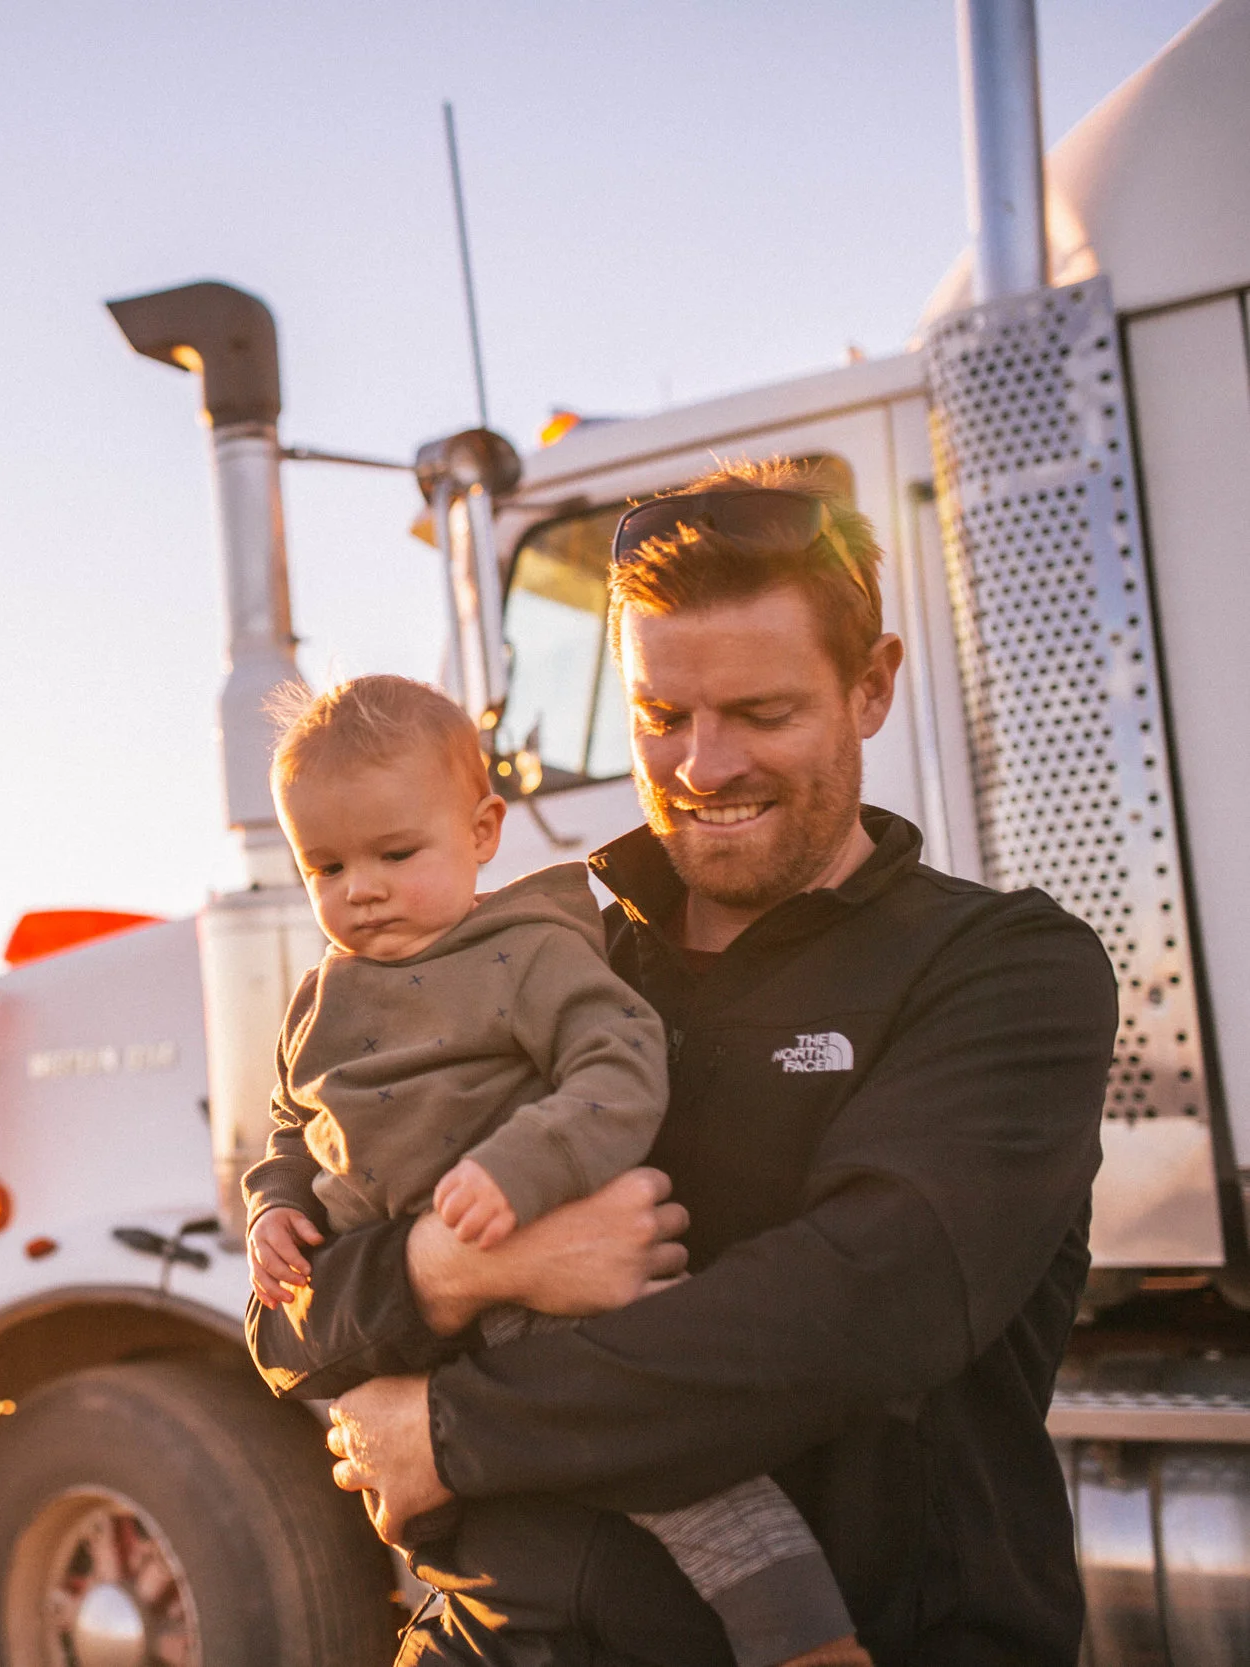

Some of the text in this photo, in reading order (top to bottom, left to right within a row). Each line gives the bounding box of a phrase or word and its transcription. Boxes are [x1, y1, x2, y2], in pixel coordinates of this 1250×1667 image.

[796, 1033, 829, 1047] THE
[772, 1046, 827, 1062] NORTH
[782, 1060, 826, 1072] FACE
